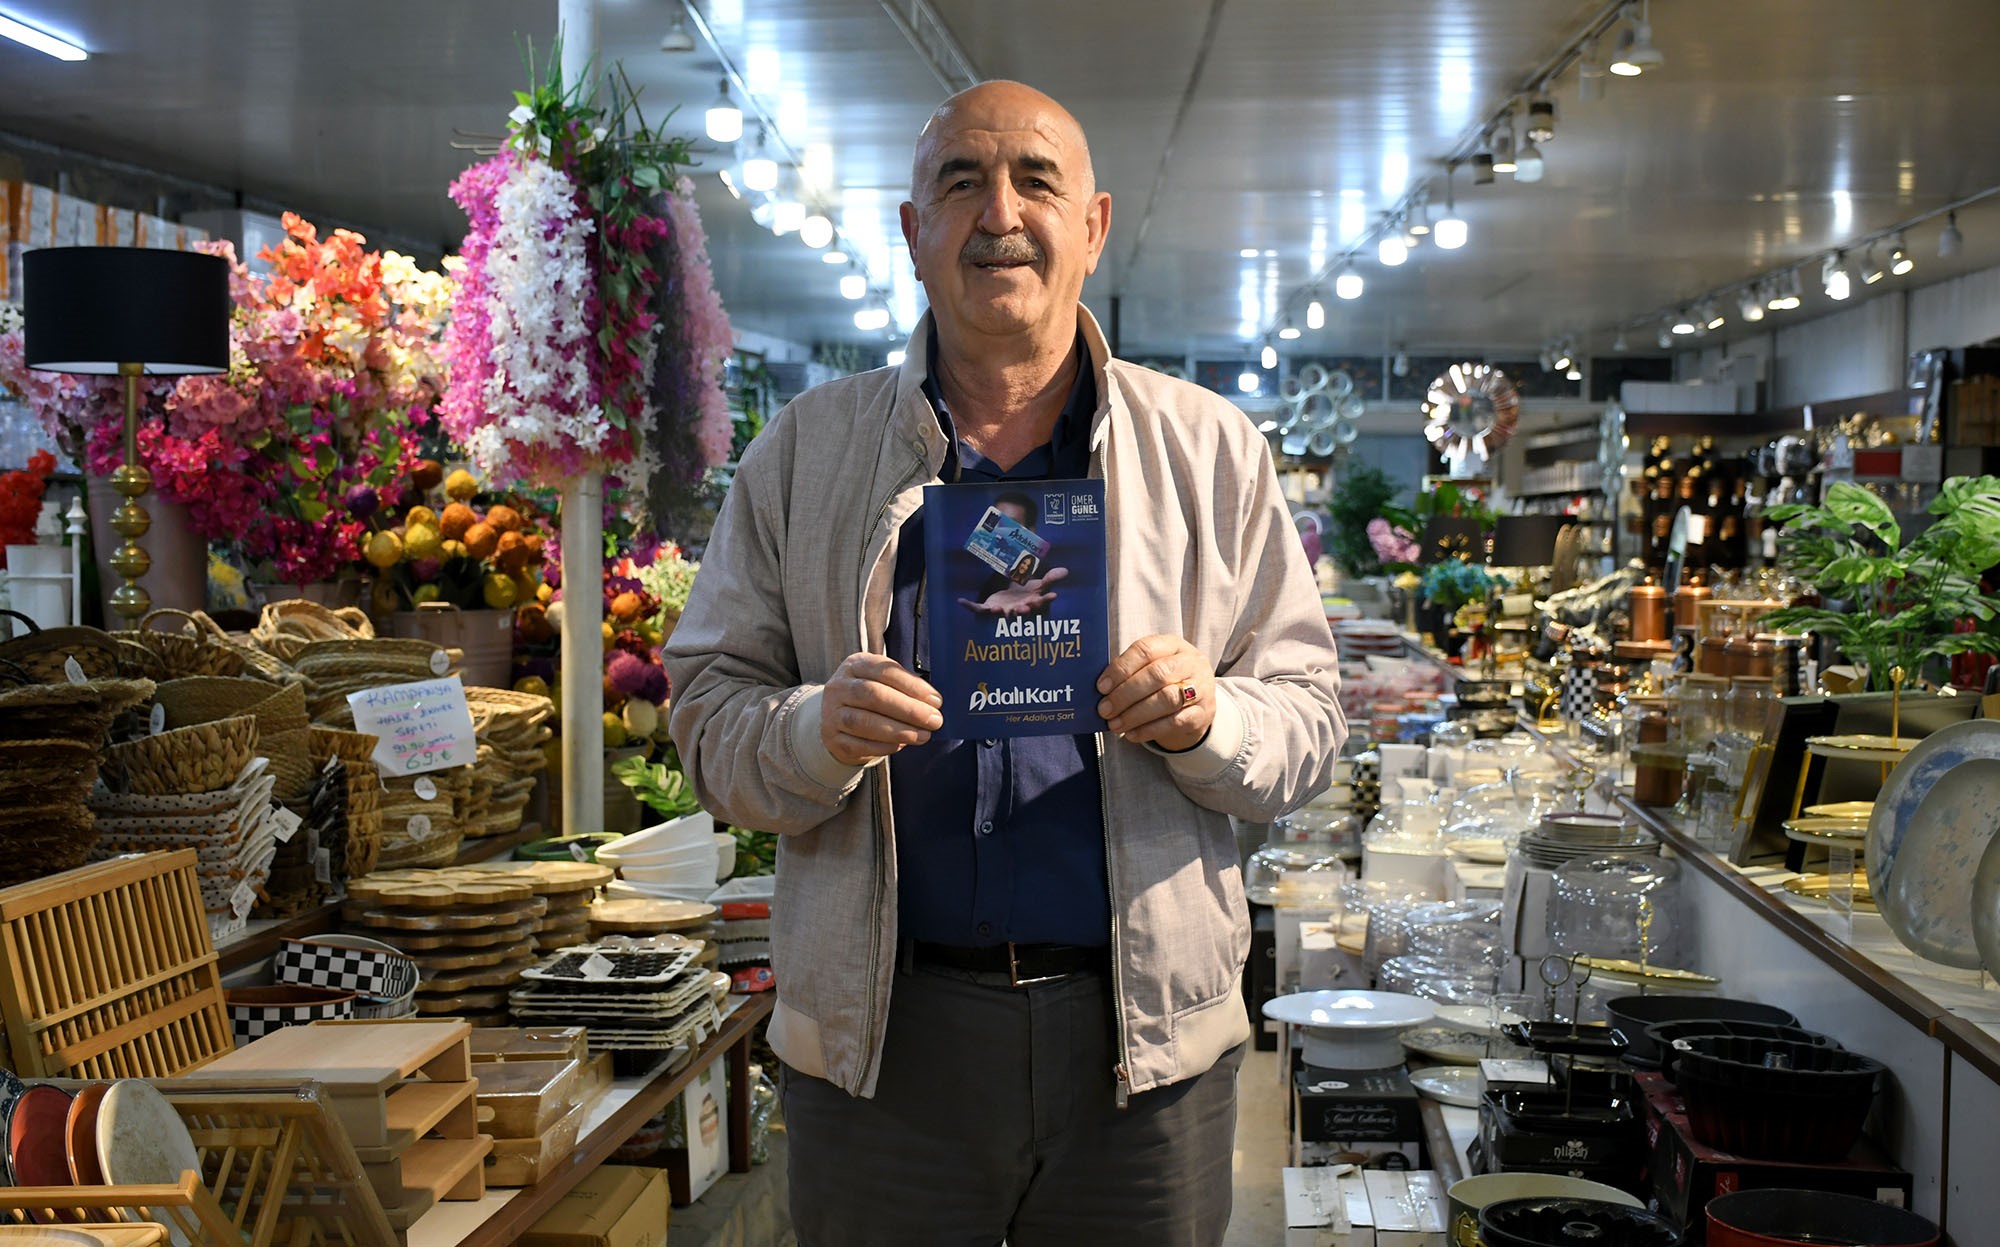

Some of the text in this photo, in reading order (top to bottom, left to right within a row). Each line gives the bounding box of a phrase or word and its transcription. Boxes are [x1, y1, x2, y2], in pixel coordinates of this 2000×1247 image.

[1071, 504, 1099, 515] GÜNEL
[995, 614, 1081, 641] Adalıyız
[964, 634, 1081, 667] Avantajlıyız!
[1005, 712, 1075, 723] Her Adalıya Şart
